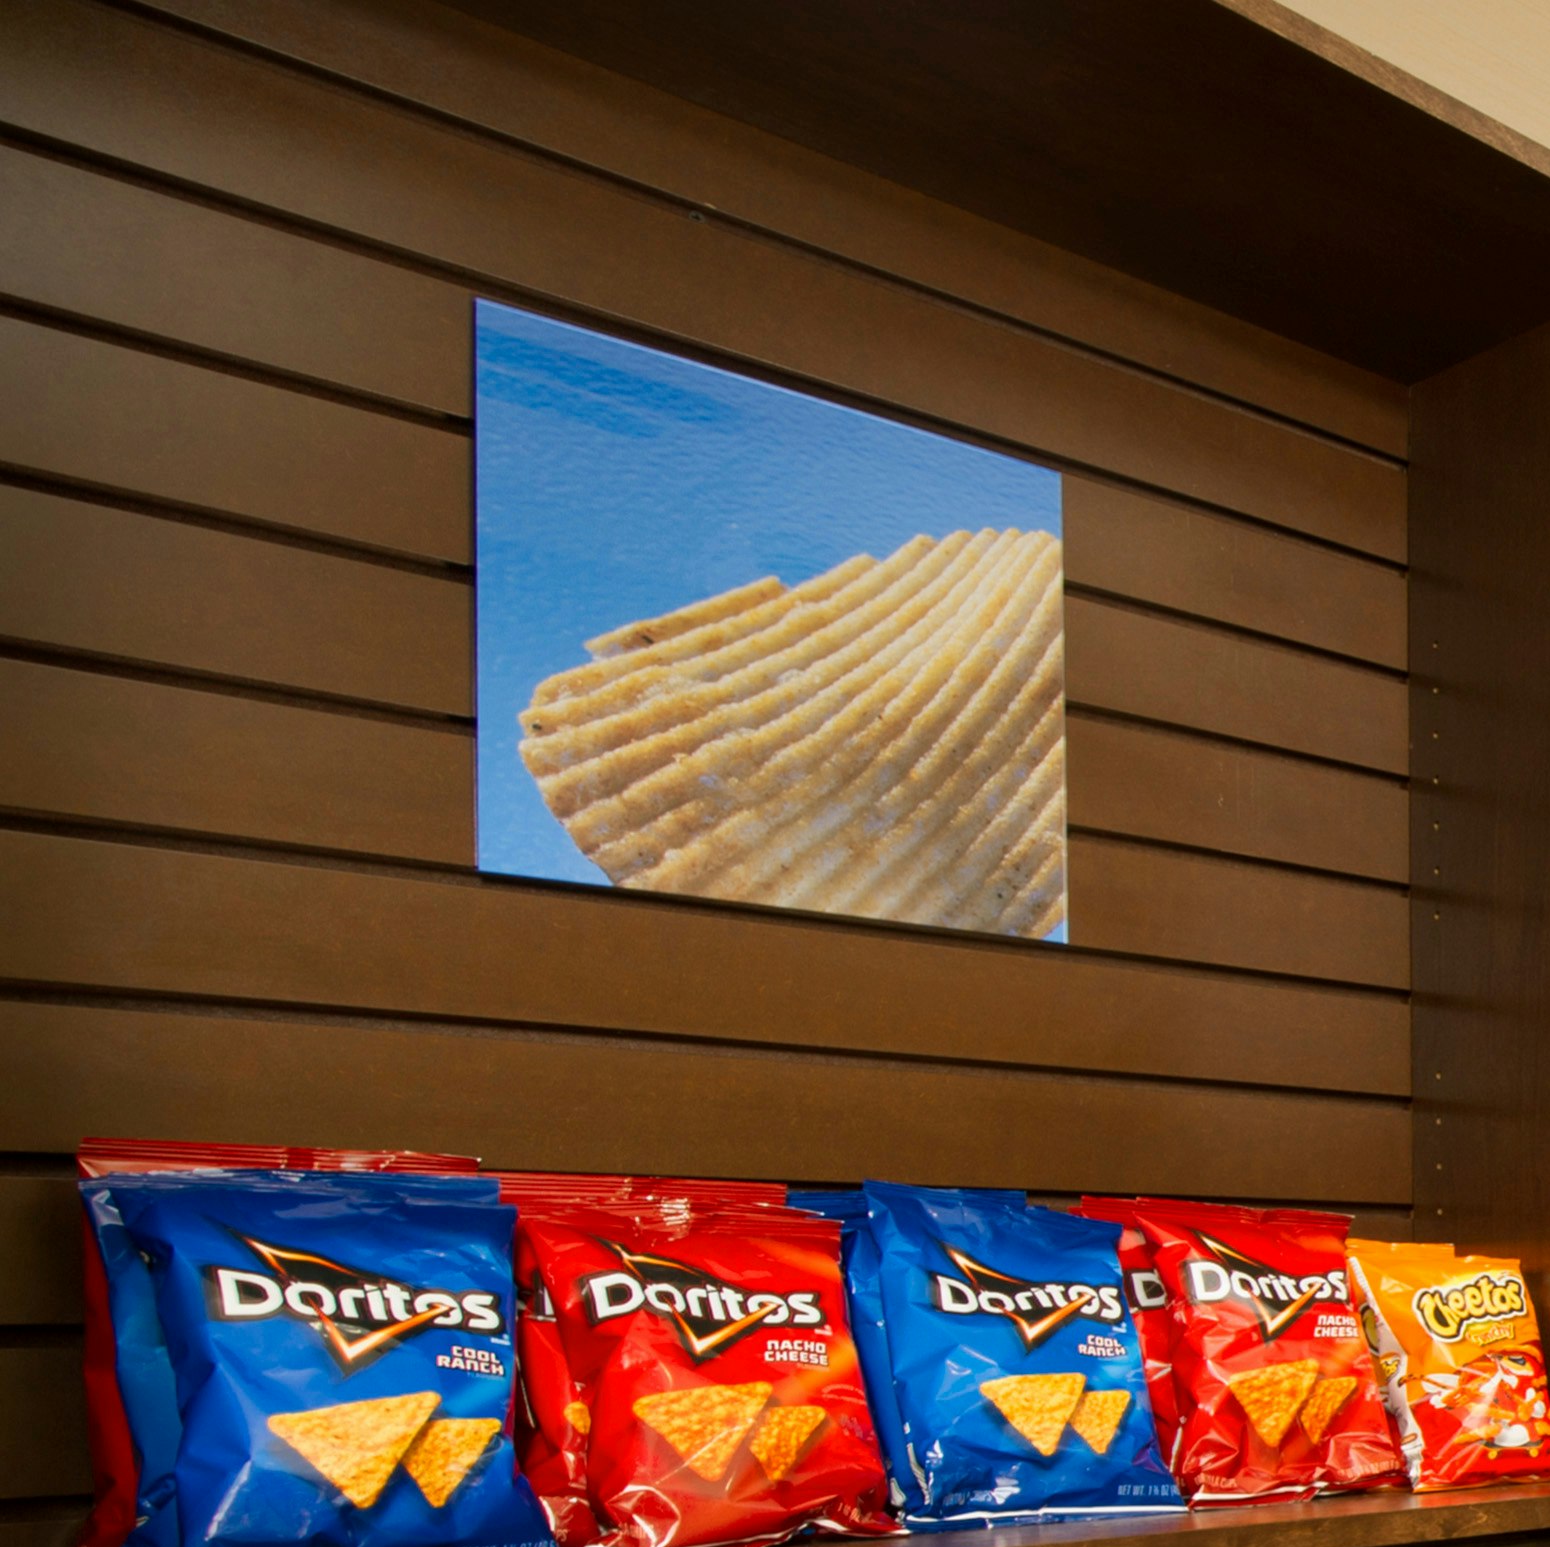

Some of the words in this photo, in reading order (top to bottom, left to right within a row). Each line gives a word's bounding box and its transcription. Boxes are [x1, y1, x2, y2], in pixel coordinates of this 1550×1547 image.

[1190, 1261, 1350, 1303] Doritos
[216, 1268, 501, 1330] Doritos
[587, 1271, 823, 1325] Doritos
[936, 1274, 1123, 1320] Doritos
[1413, 1273, 1525, 1340] Cheetos
[766, 1339, 827, 1355] NACHO
[1077, 1343, 1127, 1358] RANCH
[1086, 1334, 1122, 1349] COOL
[435, 1354, 505, 1376] RANCH
[451, 1344, 501, 1364] COOL
[763, 1350, 830, 1368] CHEESE
